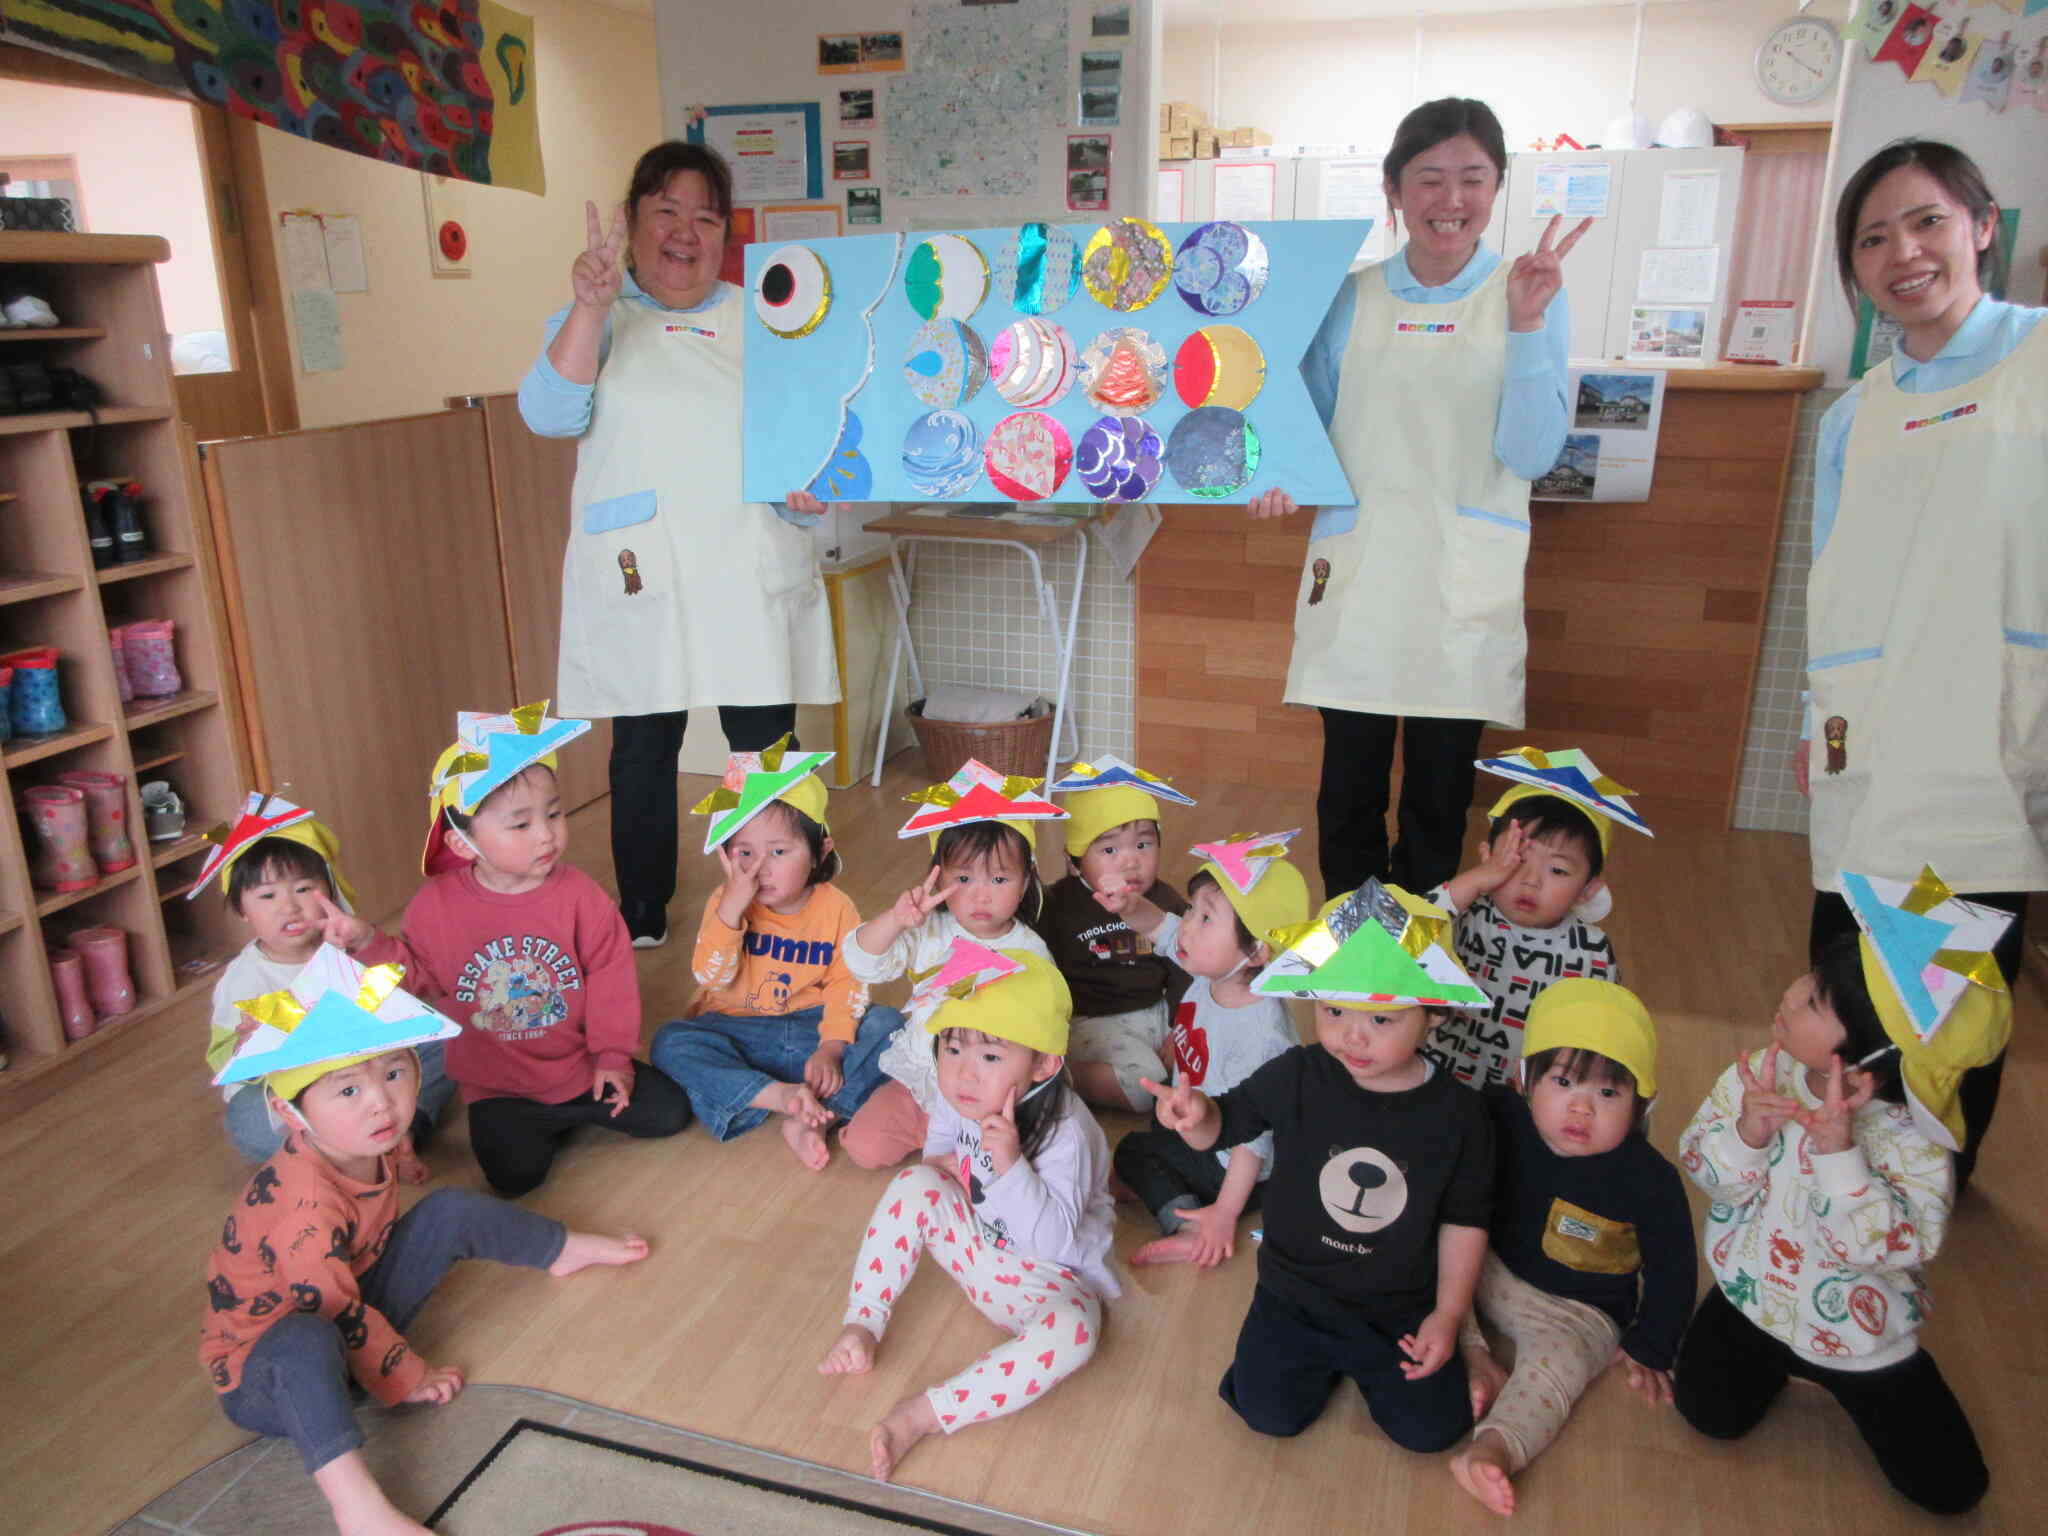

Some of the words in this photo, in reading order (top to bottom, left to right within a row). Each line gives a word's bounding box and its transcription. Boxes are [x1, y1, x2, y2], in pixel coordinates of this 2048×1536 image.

[1076, 921, 1131, 942] TIROLCHO
[456, 936, 516, 1003] SESAME
[521, 936, 581, 992] STREET
[1513, 945, 1583, 978] FILA
[1452, 1010, 1510, 1050] FILA
